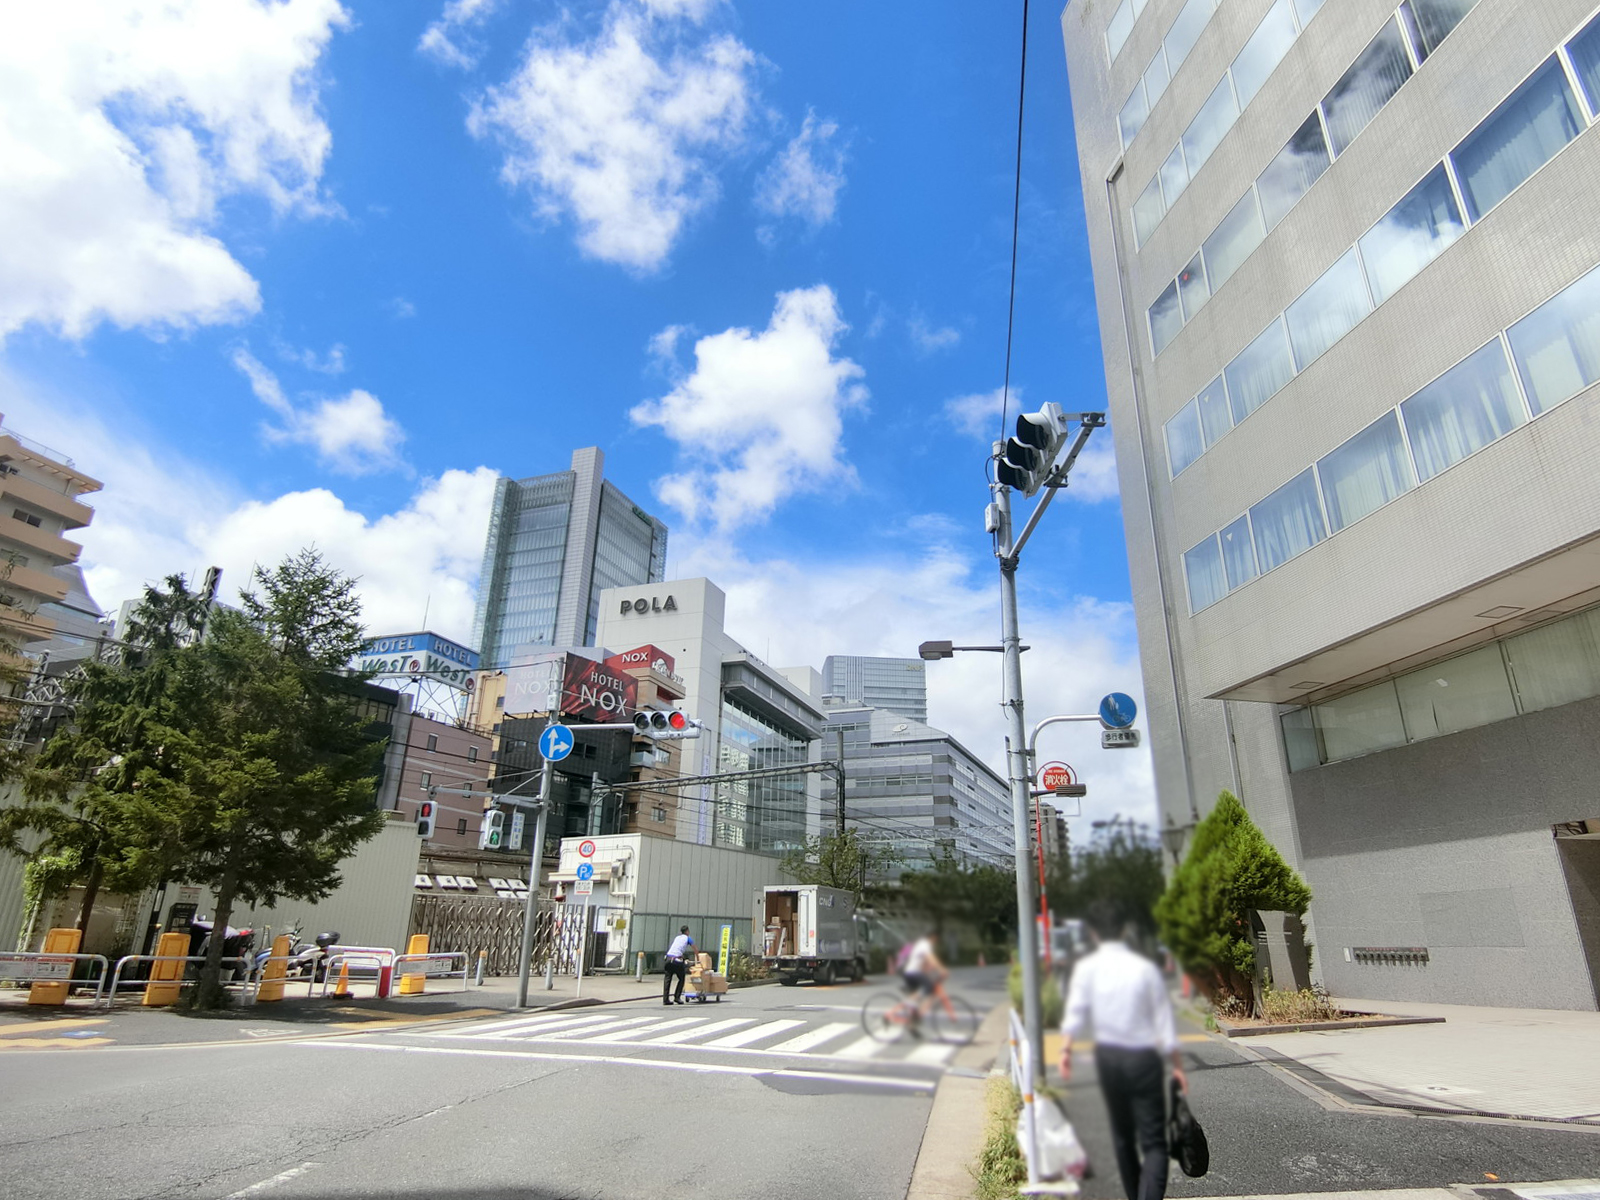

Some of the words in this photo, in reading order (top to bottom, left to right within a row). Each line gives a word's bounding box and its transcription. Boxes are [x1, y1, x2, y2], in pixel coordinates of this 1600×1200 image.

[620, 595, 678, 616] POLA
[369, 637, 415, 654] HOTEL
[434, 639, 472, 667] HOTEL
[621, 651, 648, 663] NOX
[591, 671, 624, 691] HOTEL
[580, 683, 628, 717] NOX
[1044, 773, 1069, 785] 消火栓
[583, 844, 593, 853] 40
[579, 866, 588, 878] P
